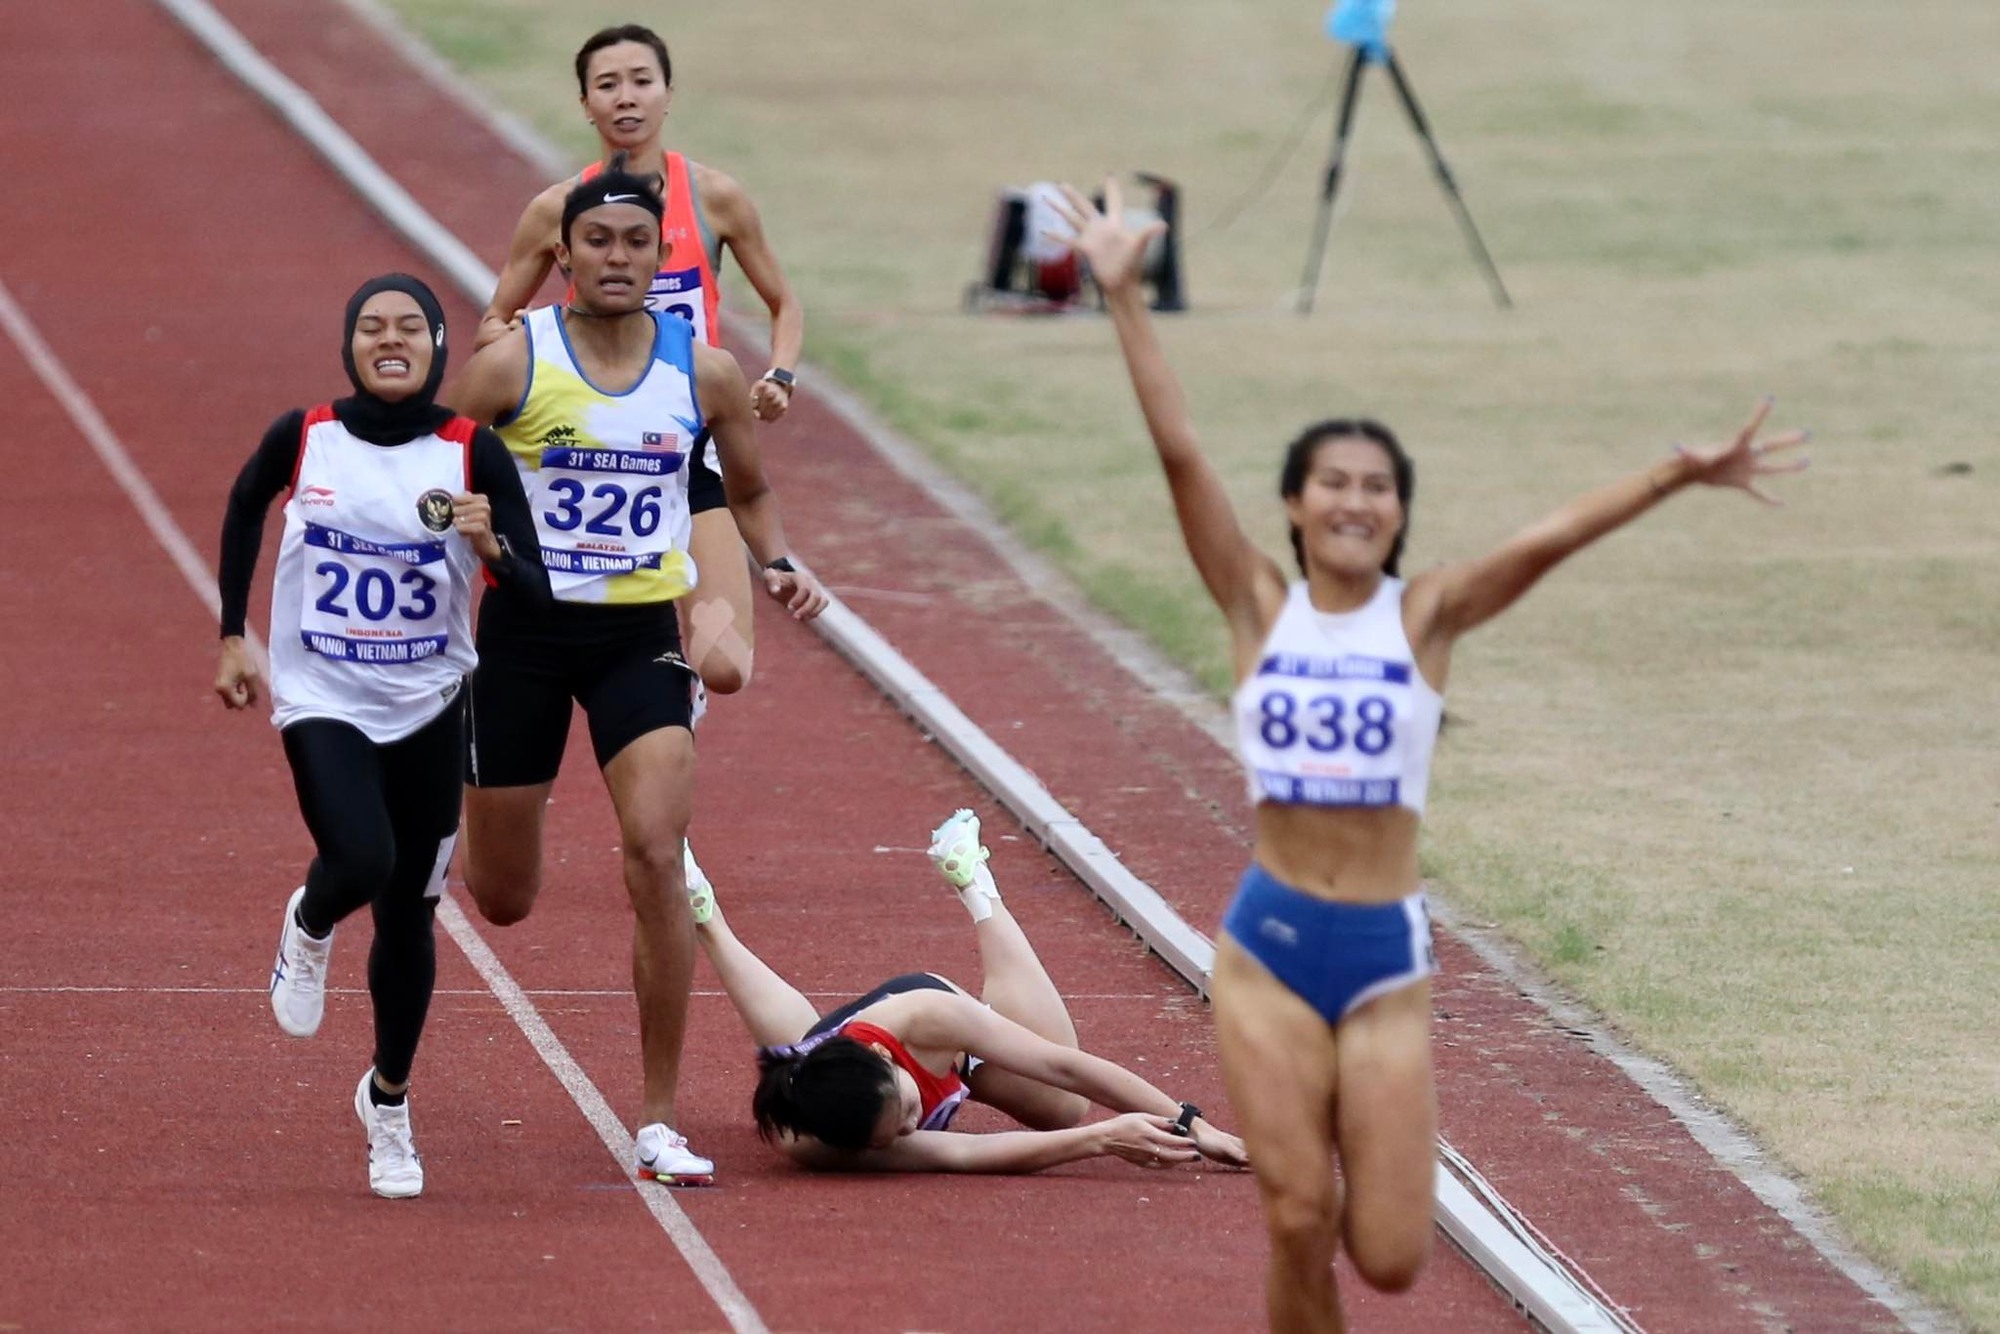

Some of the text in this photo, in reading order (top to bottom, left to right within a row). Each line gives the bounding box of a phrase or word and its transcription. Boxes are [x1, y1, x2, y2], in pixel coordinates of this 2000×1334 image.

[649, 277, 681, 292] ames
[593, 452, 617, 469] SEA
[620, 454, 662, 473] Games
[543, 478, 663, 538] 326
[577, 543, 625, 552] MALAYSIA
[581, 555, 633, 571] VIETNAM
[315, 561, 436, 620] 203
[346, 628, 403, 637] INDONESIA
[311, 635, 346, 657] HANOI
[355, 642, 408, 660] VIETNAM
[1260, 690, 1393, 756] 838
